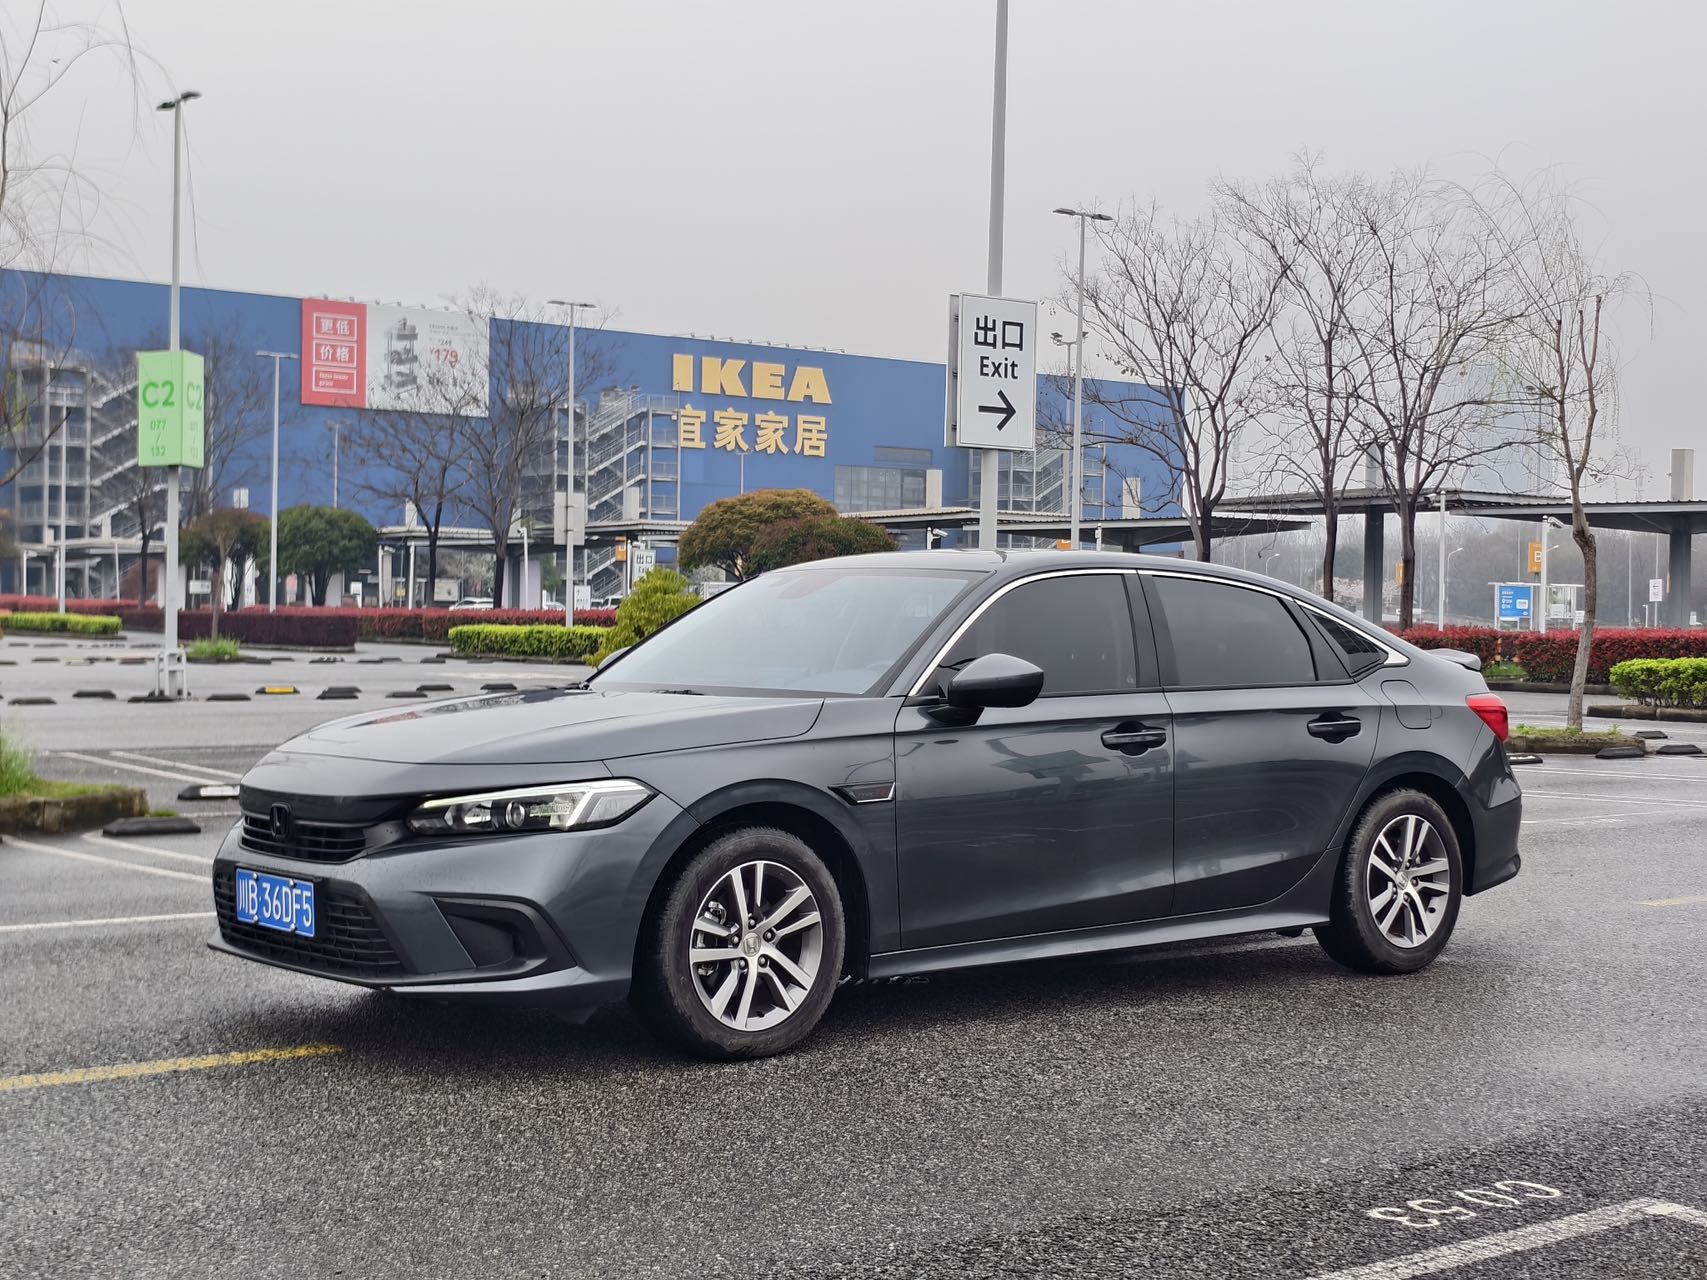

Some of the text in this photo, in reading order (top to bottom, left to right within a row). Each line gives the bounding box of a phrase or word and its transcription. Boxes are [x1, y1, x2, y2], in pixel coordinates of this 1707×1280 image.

[320, 319, 350, 335] 更低
[974, 315, 1024, 351] 出口
[320, 345, 350, 362] 价格
[979, 355, 1018, 380] Exit
[672, 353, 833, 404] IKEA
[142, 380, 175, 408] C2
[186, 382, 202, 411] C2
[672, 404, 828, 458] 宜家家居
